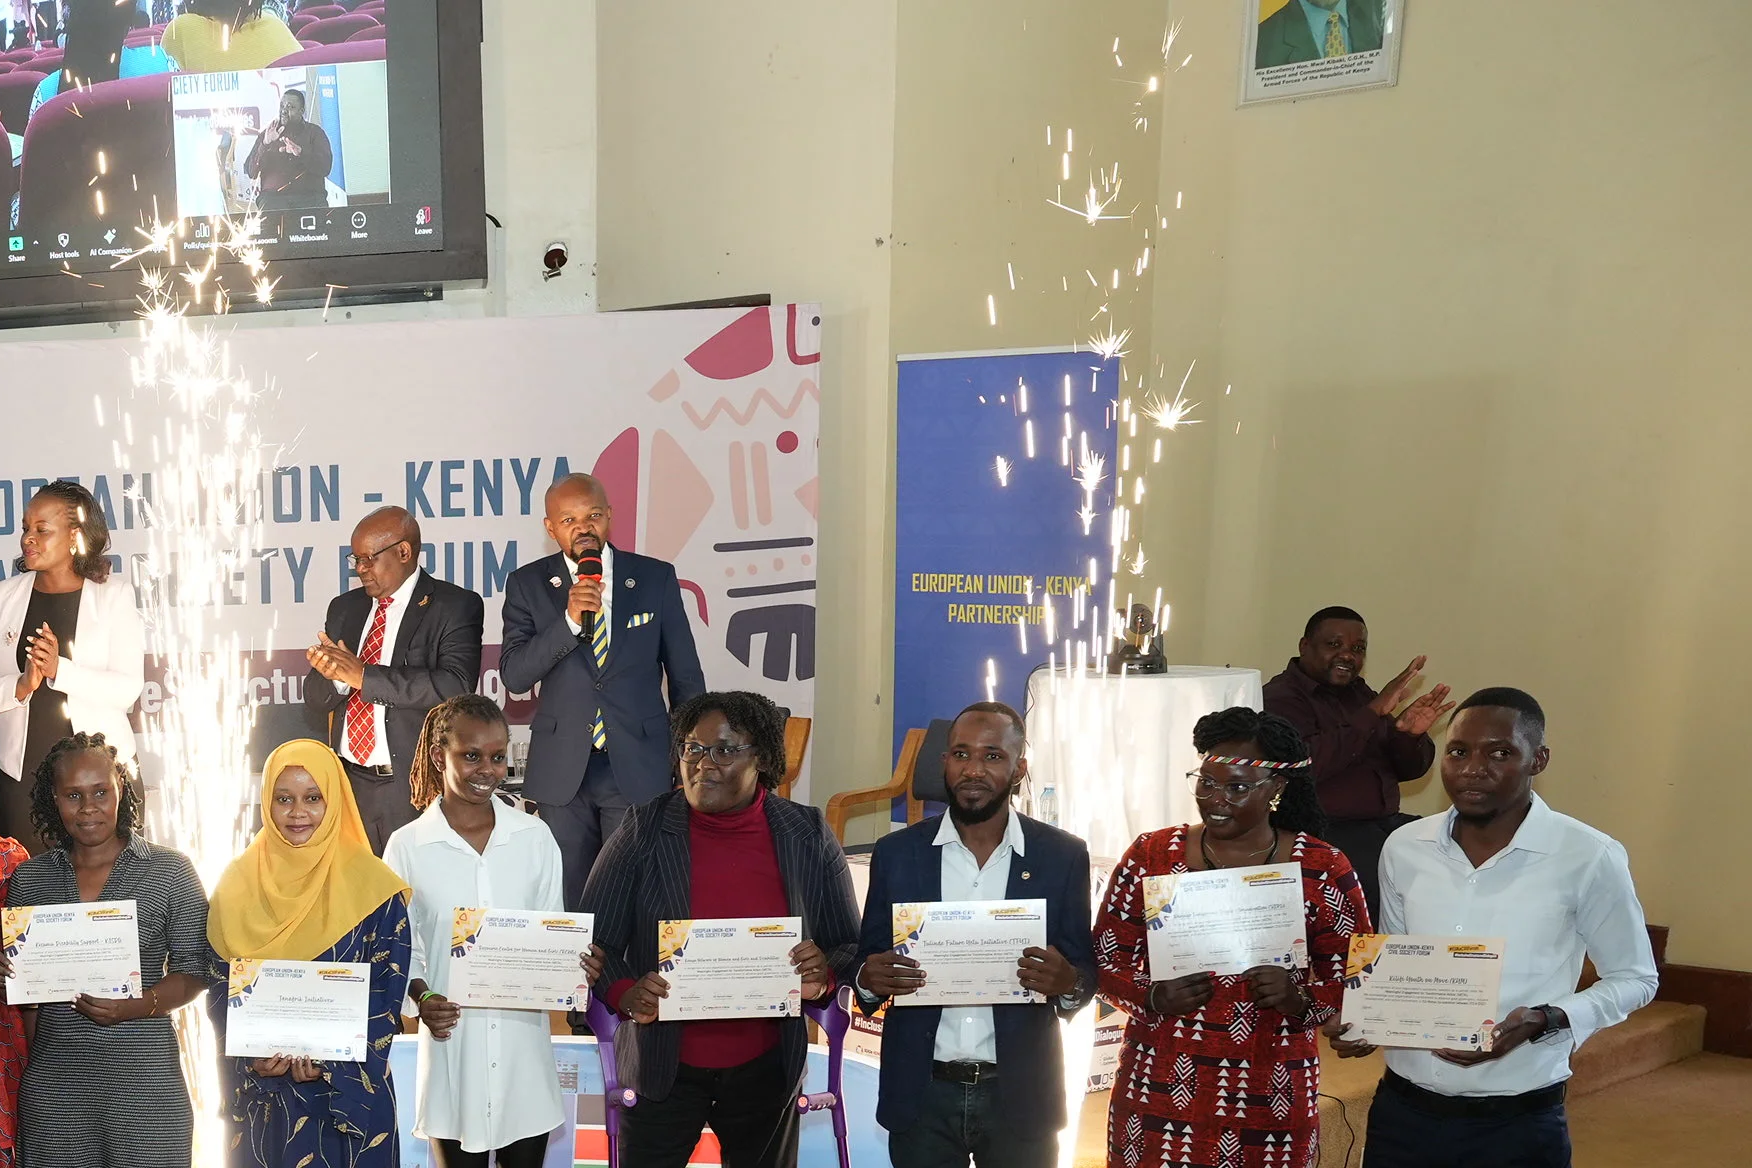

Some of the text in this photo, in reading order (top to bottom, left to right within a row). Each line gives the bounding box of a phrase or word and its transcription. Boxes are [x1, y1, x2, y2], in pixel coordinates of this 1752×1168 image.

[204, 72, 239, 92] FORUM
[351, 231, 368, 239] More
[414, 227, 433, 235] Leave
[290, 234, 328, 242] Whiteboards
[49, 250, 79, 259] Host tools
[98, 247, 132, 256] Companion
[8, 254, 25, 263] Share
[912, 573, 983, 593] EUROPEAN
